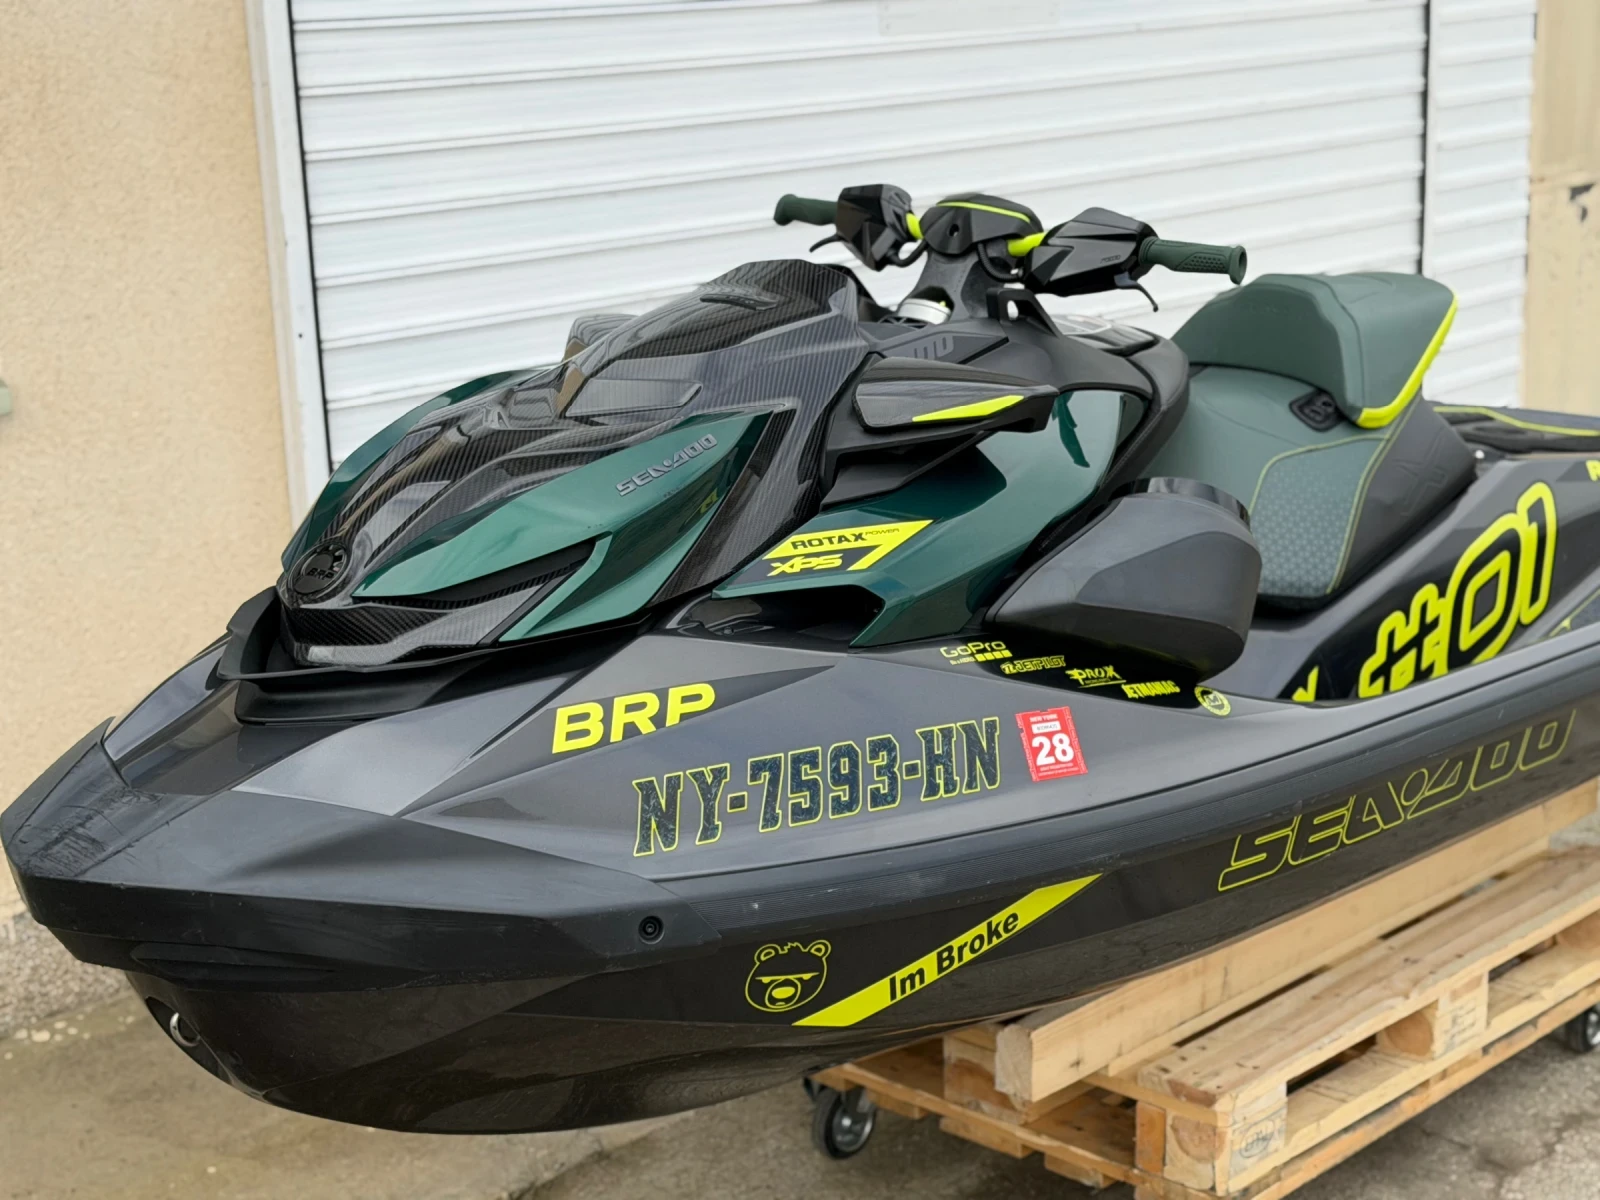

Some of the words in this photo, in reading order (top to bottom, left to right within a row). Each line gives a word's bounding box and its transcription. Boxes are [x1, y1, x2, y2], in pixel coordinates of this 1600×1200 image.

[791, 532, 867, 550] ROTAX
[865, 528, 900, 536] POWER
[766, 553, 844, 577] XPS
[939, 641, 1007, 658] GoPro
[551, 682, 716, 754] BRP
[1032, 732, 1075, 767] 28
[631, 716, 1001, 858] NY-7593-HN
[888, 966, 927, 1003] Im
[935, 912, 1020, 973] Broke
